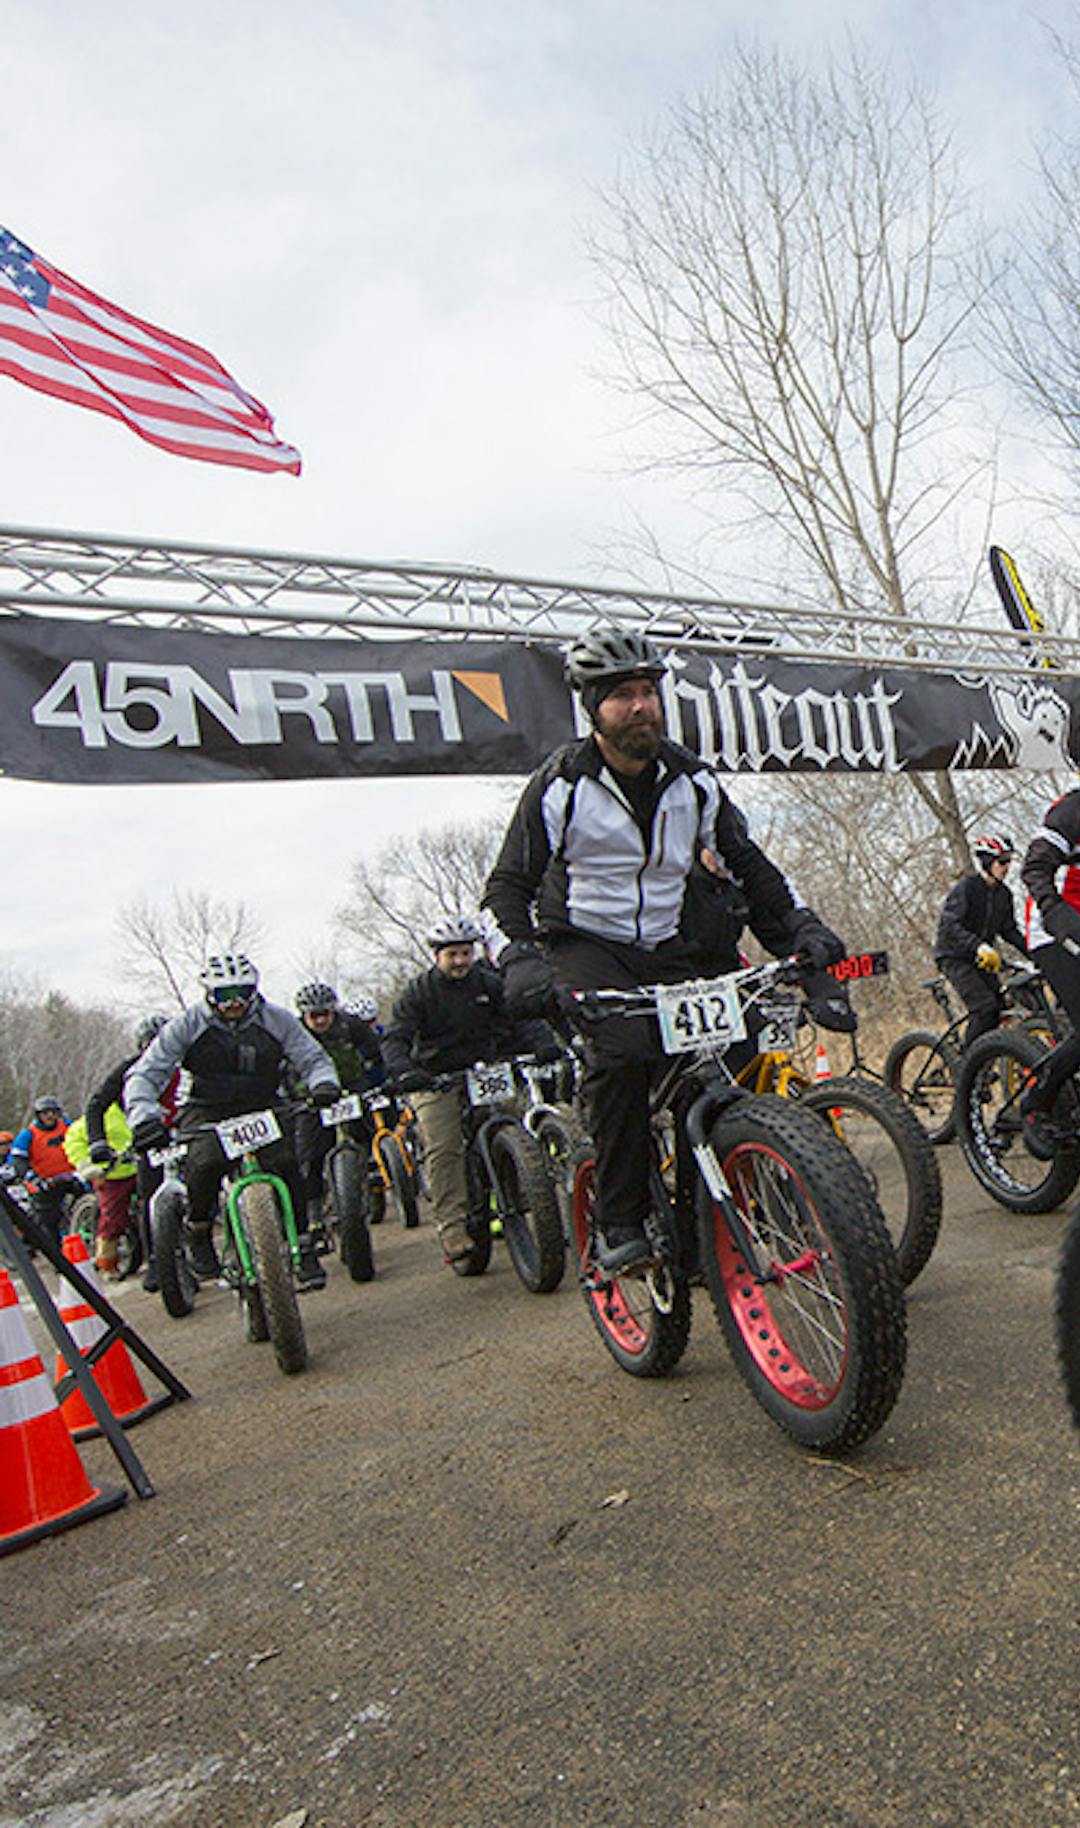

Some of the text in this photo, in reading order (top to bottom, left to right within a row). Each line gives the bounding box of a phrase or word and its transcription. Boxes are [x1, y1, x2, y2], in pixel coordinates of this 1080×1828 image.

[32, 659, 464, 750] 45NRTH
[571, 648, 904, 773] hiteout
[674, 997, 729, 1036] 412
[232, 1118, 269, 1145] 400
